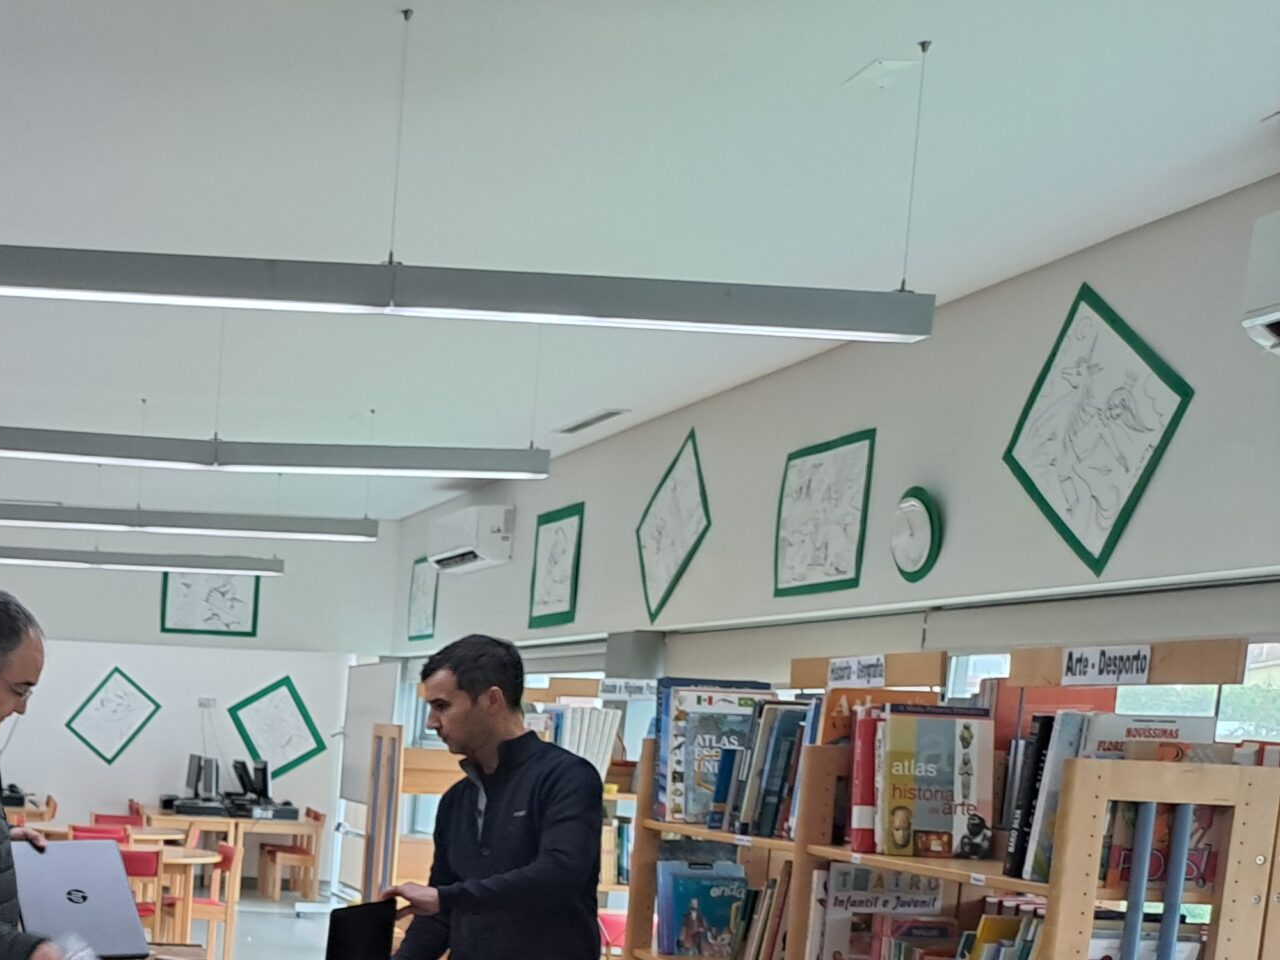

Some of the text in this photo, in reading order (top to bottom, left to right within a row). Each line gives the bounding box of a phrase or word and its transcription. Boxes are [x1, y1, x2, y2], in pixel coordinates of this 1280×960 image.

[1065, 651, 1089, 676] Arte
[1098, 650, 1147, 682] Desporto
[694, 734, 739, 748] ATLAS
[1097, 740, 1126, 752] FLORE
[694, 760, 719, 774] UNI
[892, 760, 937, 777] atlas
[942, 801, 977, 816] arte
[837, 868, 939, 891] TATRO
[833, 896, 937, 910] Infantil e Juvenil
